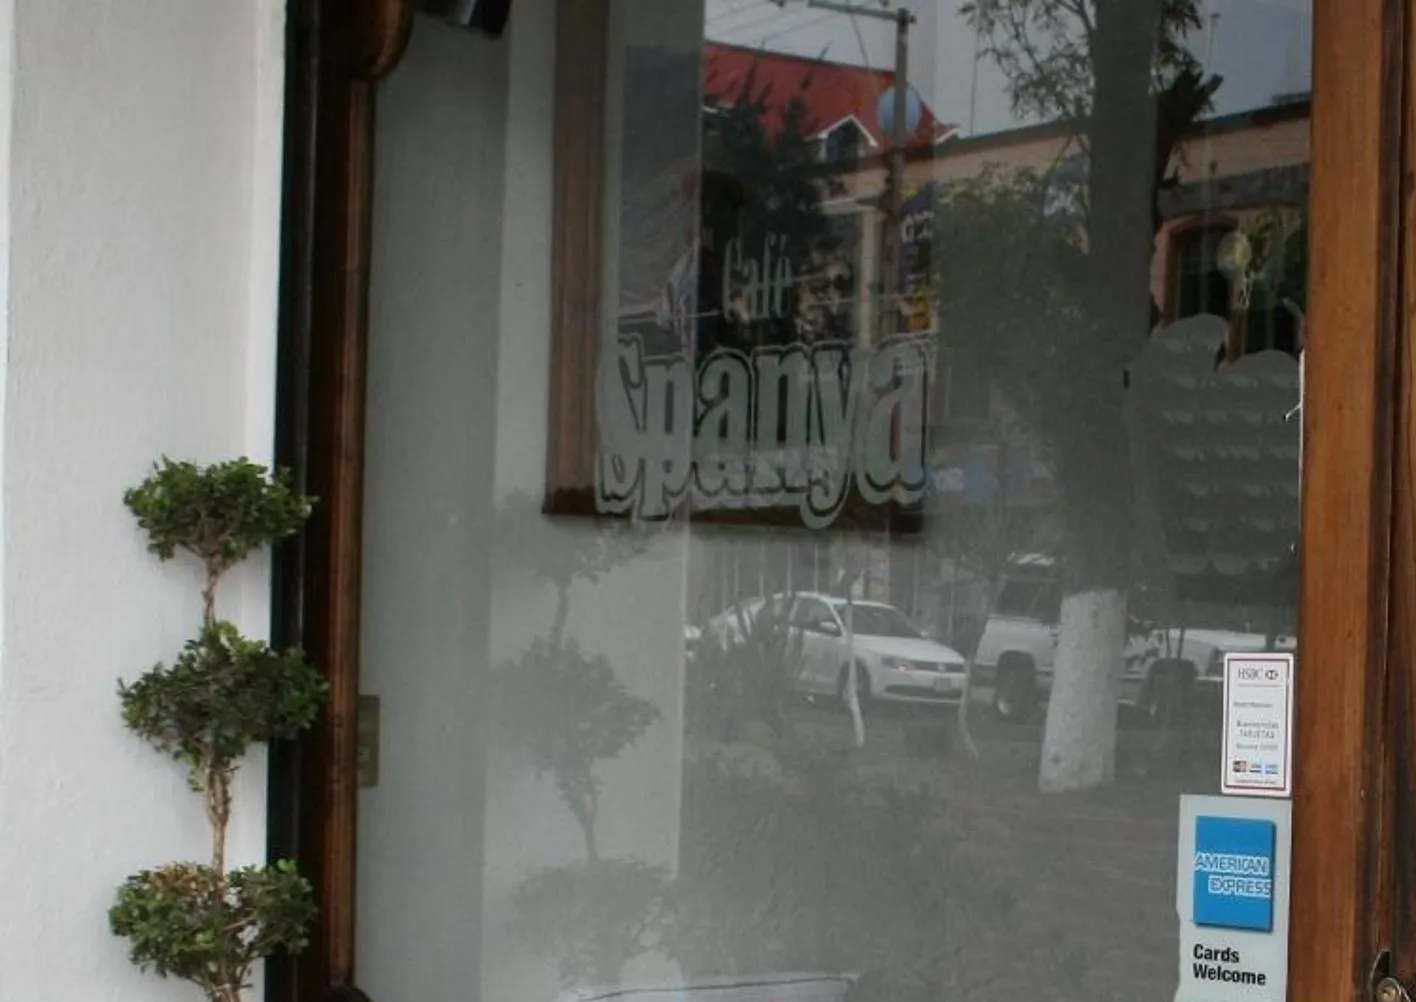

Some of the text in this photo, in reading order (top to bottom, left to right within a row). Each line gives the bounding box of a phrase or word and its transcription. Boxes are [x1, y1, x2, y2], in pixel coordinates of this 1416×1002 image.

[722, 233, 793, 322] Café
[597, 332, 932, 529] Spanya
[1194, 852, 1269, 876] AMERICAN
[1208, 876, 1272, 898] EXPRESS
[1193, 943, 1240, 964] Cards
[1193, 963, 1267, 986] Welcome
